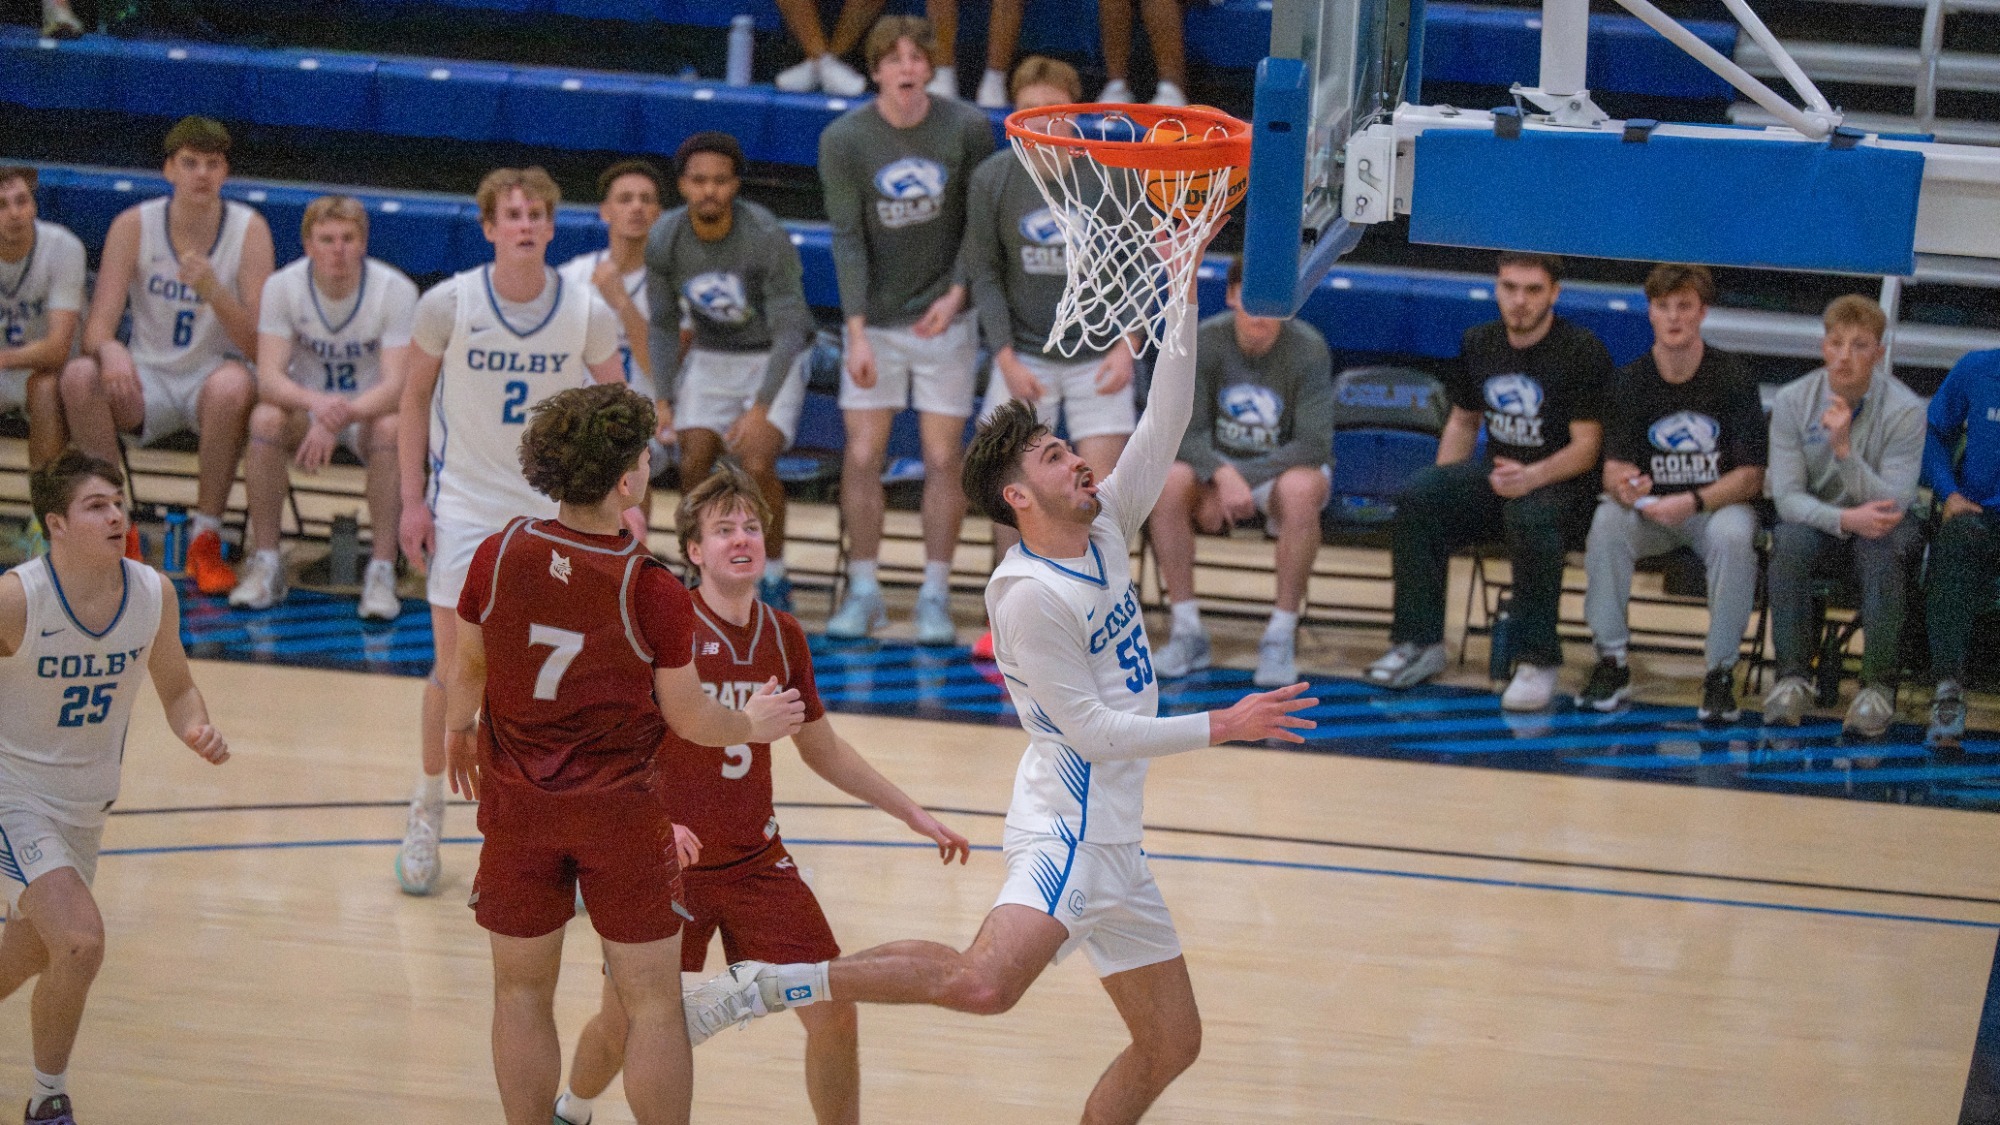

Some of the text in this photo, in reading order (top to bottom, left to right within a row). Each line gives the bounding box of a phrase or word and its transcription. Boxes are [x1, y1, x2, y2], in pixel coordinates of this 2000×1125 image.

[1178, 177, 1247, 206] Wion
[172, 310, 195, 348] 6
[324, 363, 358, 391] 12
[467, 349, 570, 374] COLBY
[502, 380, 529, 424] 2
[1650, 452, 1721, 472] COLBY
[528, 622, 585, 701] 7
[1116, 623, 1153, 695] 55
[57, 682, 118, 727] 25
